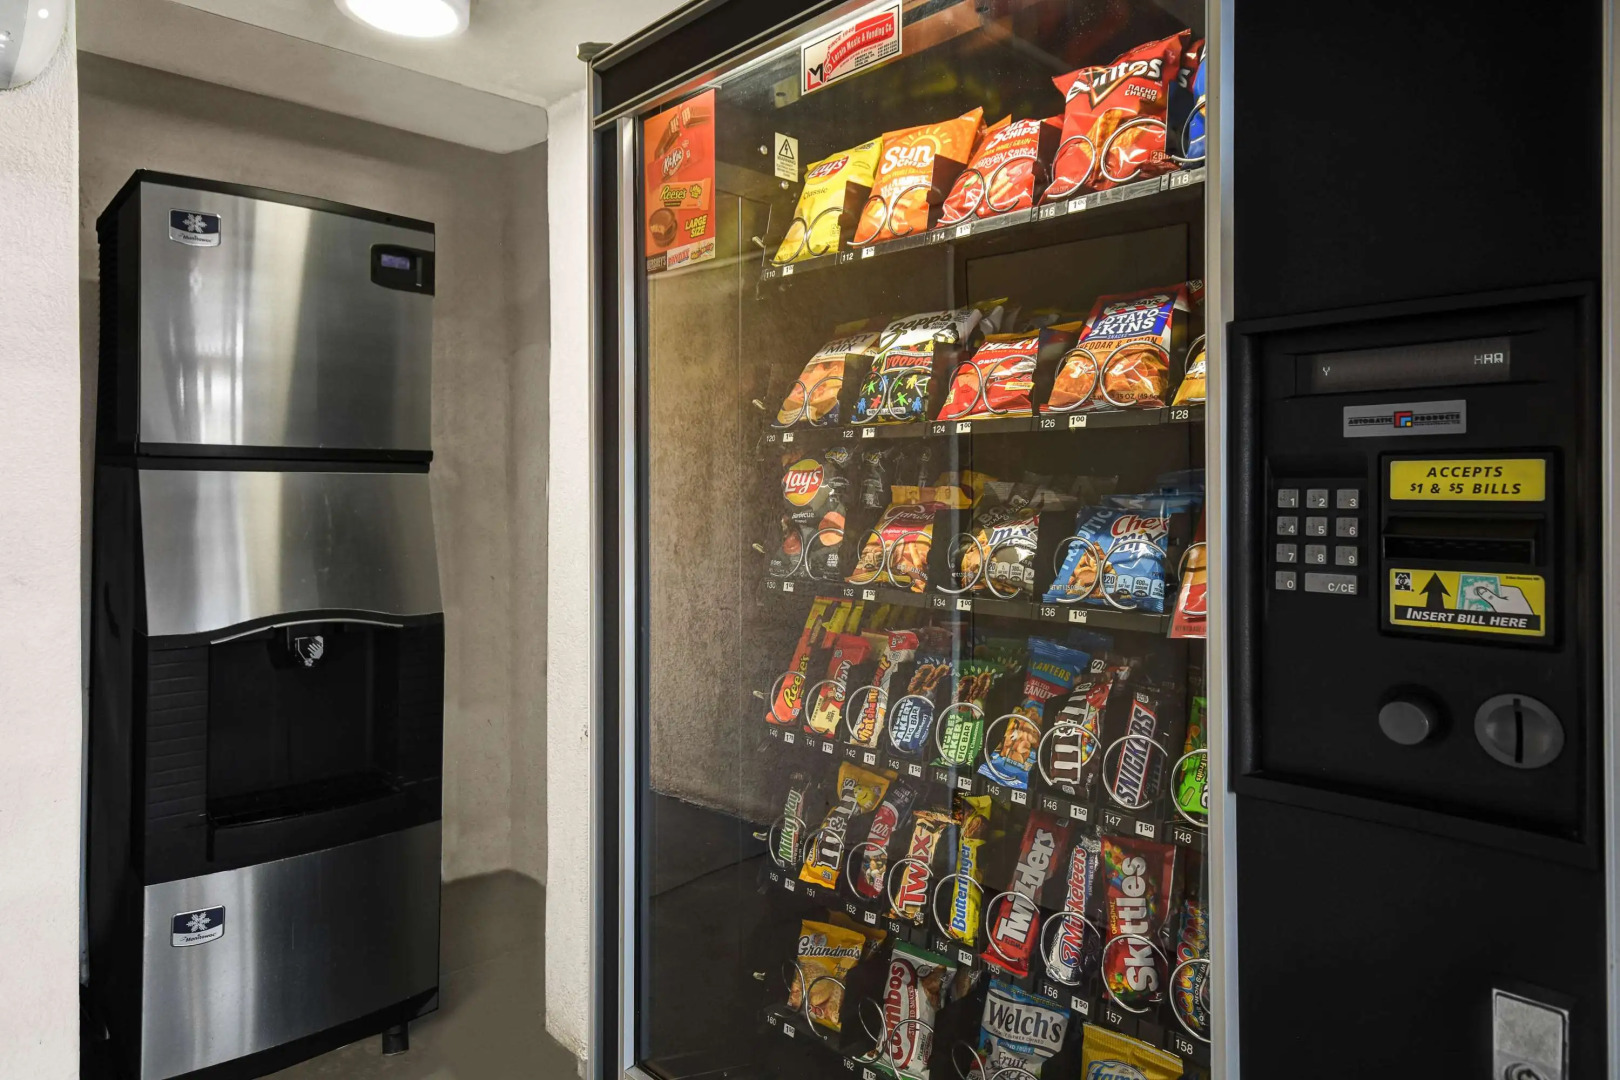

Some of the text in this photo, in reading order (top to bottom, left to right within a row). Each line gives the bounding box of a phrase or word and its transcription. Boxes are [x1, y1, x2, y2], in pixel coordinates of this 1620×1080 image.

[1128, 83, 1157, 96] NACHO
[1125, 89, 1157, 101] CHEESE
[881, 145, 935, 175] Sun
[1170, 173, 1189, 187] 118
[1039, 207, 1056, 219] 116
[685, 215, 707, 230] LARGE
[691, 224, 706, 238] SIZE
[932, 232, 945, 242] 114
[842, 253, 853, 261] 112
[765, 270, 776, 278] 110
[1170, 410, 1188, 420] 128
[1348, 412, 1461, 425] AUTOMATIC PRODUCTS
[1040, 419, 1056, 428] 126
[842, 430, 854, 438] 122
[933, 425, 946, 433] 124
[1426, 466, 1504, 478] ACCEPTS
[1410, 482, 1522, 495] $1 & $5 BILLS
[1319, 498, 1325, 507] 2
[1349, 498, 1356, 507] 3
[1112, 515, 1169, 536] Chex
[1288, 525, 1295, 534] 4
[1318, 526, 1325, 535] 5
[1349, 526, 1356, 535] 6
[1288, 552, 1295, 561] 7
[1317, 553, 1324, 563] 8
[1348, 555, 1355, 564] 9
[1327, 582, 1355, 593] C/CE
[843, 589, 854, 597] 132
[933, 598, 946, 606] 134
[1040, 607, 1056, 616] 136
[1406, 607, 1528, 628] INSERT BILL HERE
[806, 738, 815, 747] 141
[957, 725, 972, 761] FIG BAR
[845, 749, 856, 758] 142
[888, 759, 899, 769] 143
[936, 772, 947, 781] 144
[987, 785, 999, 795] 145
[1043, 799, 1057, 811] 146
[1105, 815, 1121, 826] 147
[1174, 831, 1192, 844] 148
[769, 872, 779, 882] 150
[806, 887, 816, 897] 151
[846, 903, 856, 914] 152
[888, 922, 900, 932] 153
[1115, 855, 1159, 992] Skittles
[936, 941, 948, 952] 154
[1043, 985, 1058, 999] 156
[766, 1015, 777, 1026] 160
[988, 998, 1063, 1044] Welch's
[1106, 1010, 1122, 1025] 157
[1175, 1039, 1193, 1055] 158
[843, 1059, 855, 1071] 162
